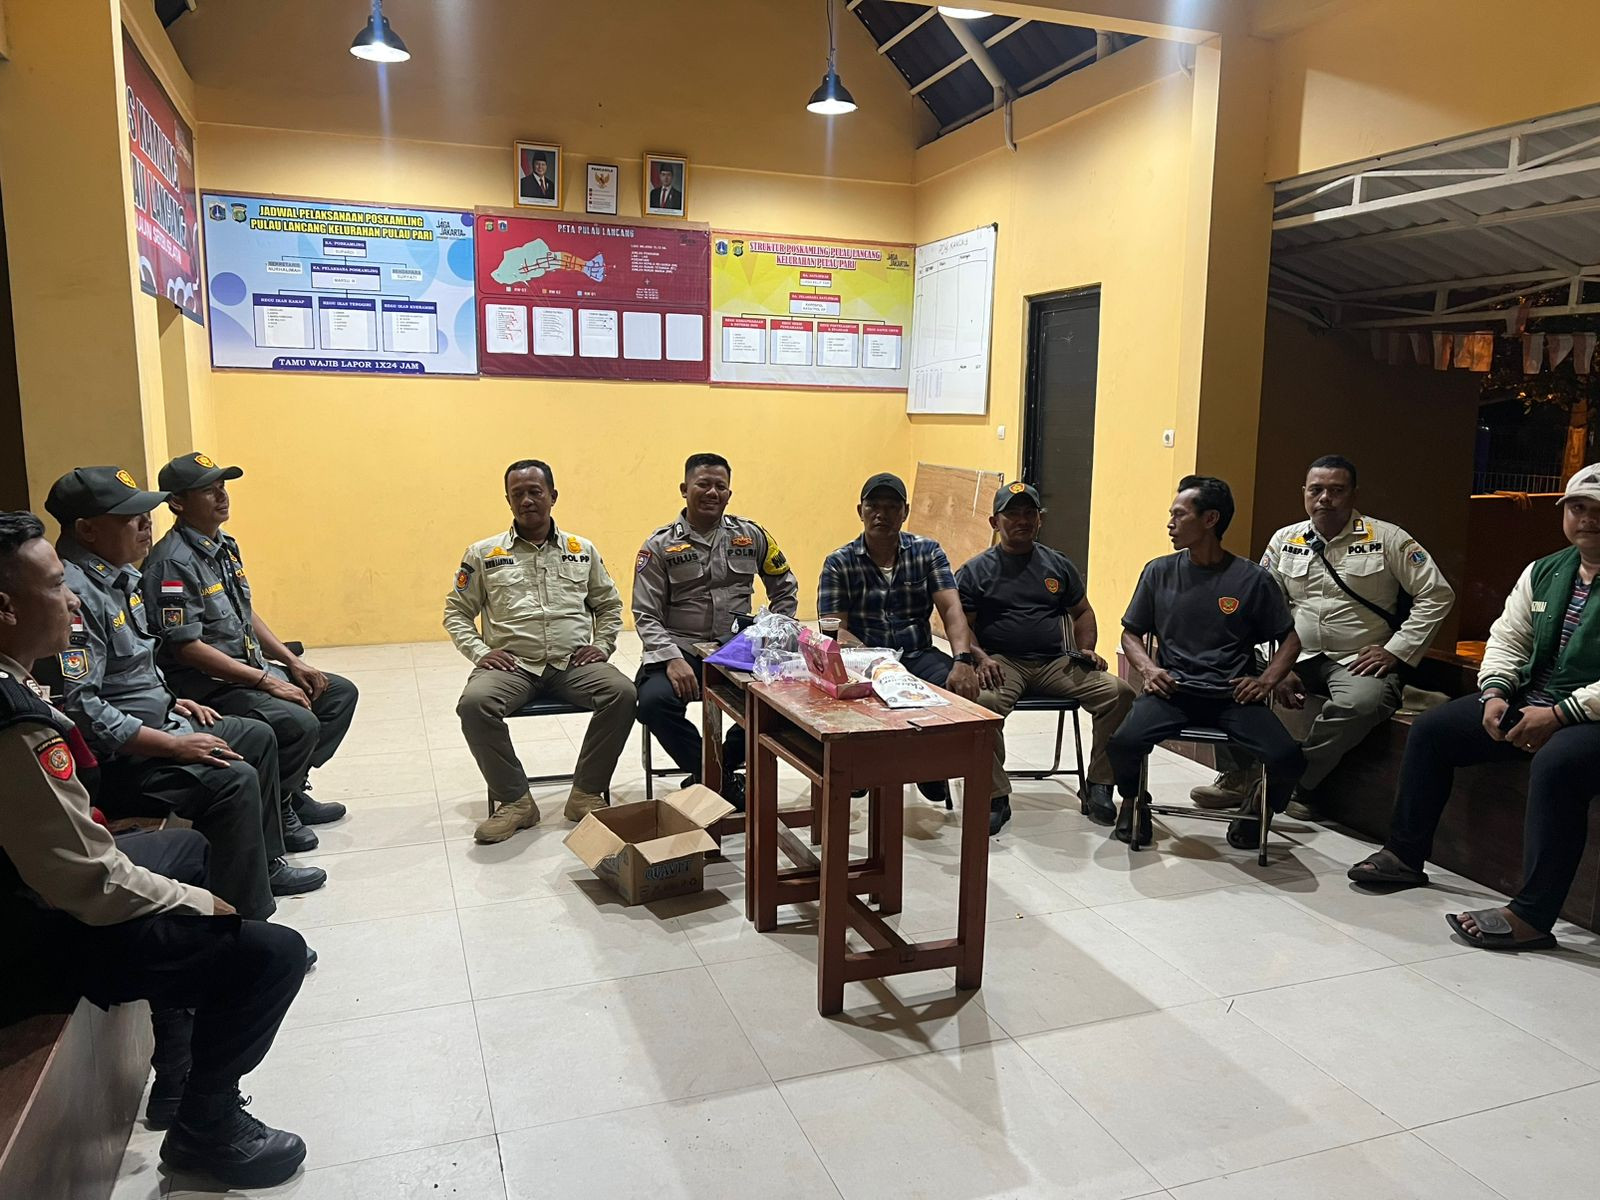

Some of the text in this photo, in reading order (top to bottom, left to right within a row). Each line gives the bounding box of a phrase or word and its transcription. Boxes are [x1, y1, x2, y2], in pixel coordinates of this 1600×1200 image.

[259, 205, 423, 227] JADWAL PELAKSANAAN POSKAMLING
[250, 218, 433, 241] PULAU LANCANG KELURAHAN PULAU PARI
[557, 224, 634, 238] PETA PULAU LANCANG
[750, 241, 881, 260] STRUKTUR POSKAMLING PULAU LANCANG
[777, 255, 856, 269] KELURAHAN PULAU PARI
[279, 358, 419, 370] TAMU WAJIB LAPOR 1X24 JAM
[727, 549, 757, 557] POLRI
[1348, 543, 1382, 554] POL PP
[561, 554, 590, 563] POL PP
[666, 552, 699, 567] TULUS
